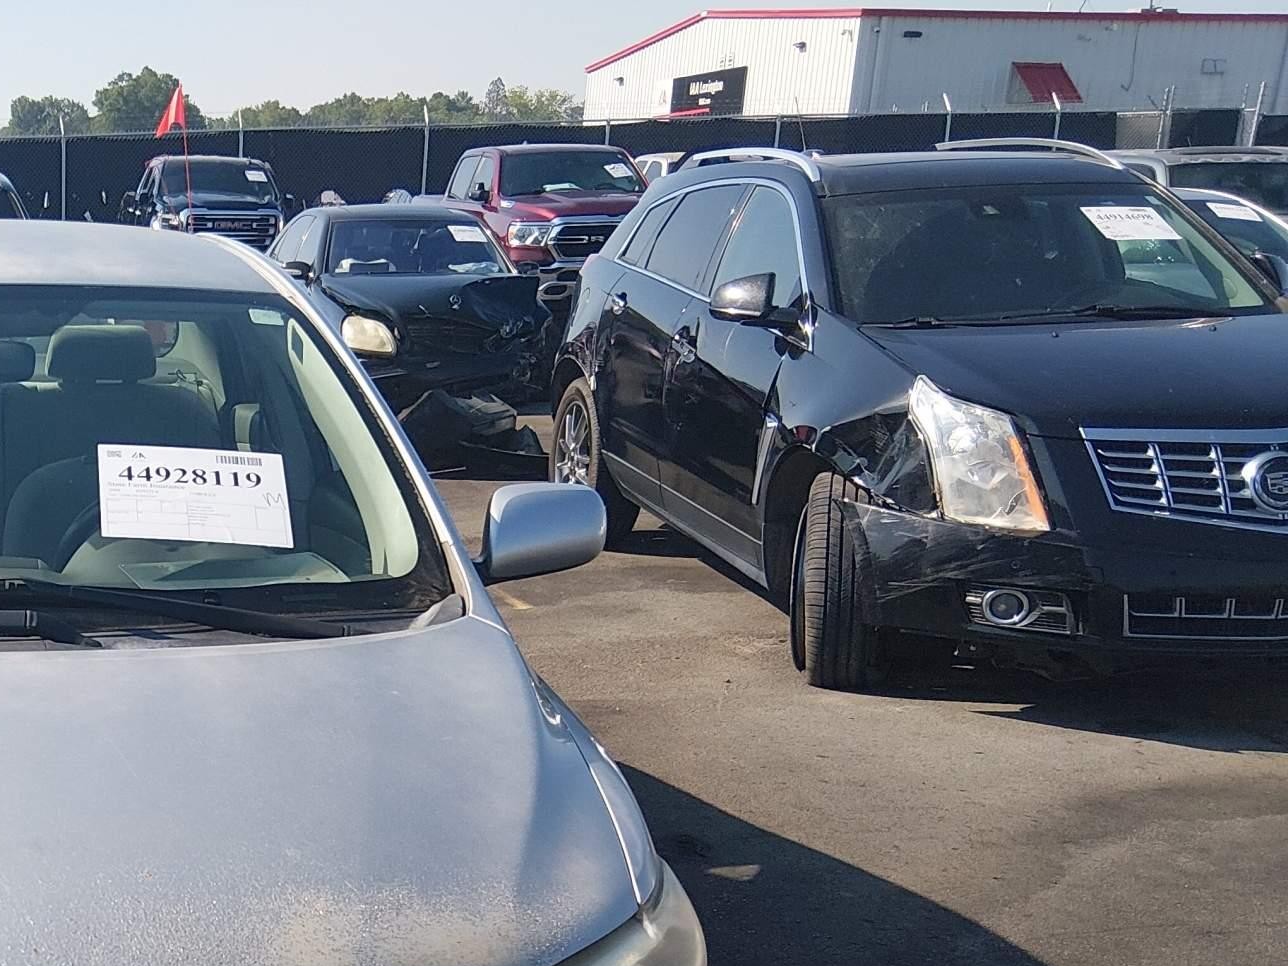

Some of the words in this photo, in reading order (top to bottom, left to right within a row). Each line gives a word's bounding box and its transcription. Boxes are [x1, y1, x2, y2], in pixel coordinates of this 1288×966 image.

[1095, 212, 1154, 221] 44914698
[214, 221, 252, 230] GMC
[117, 465, 262, 489] 44928119
